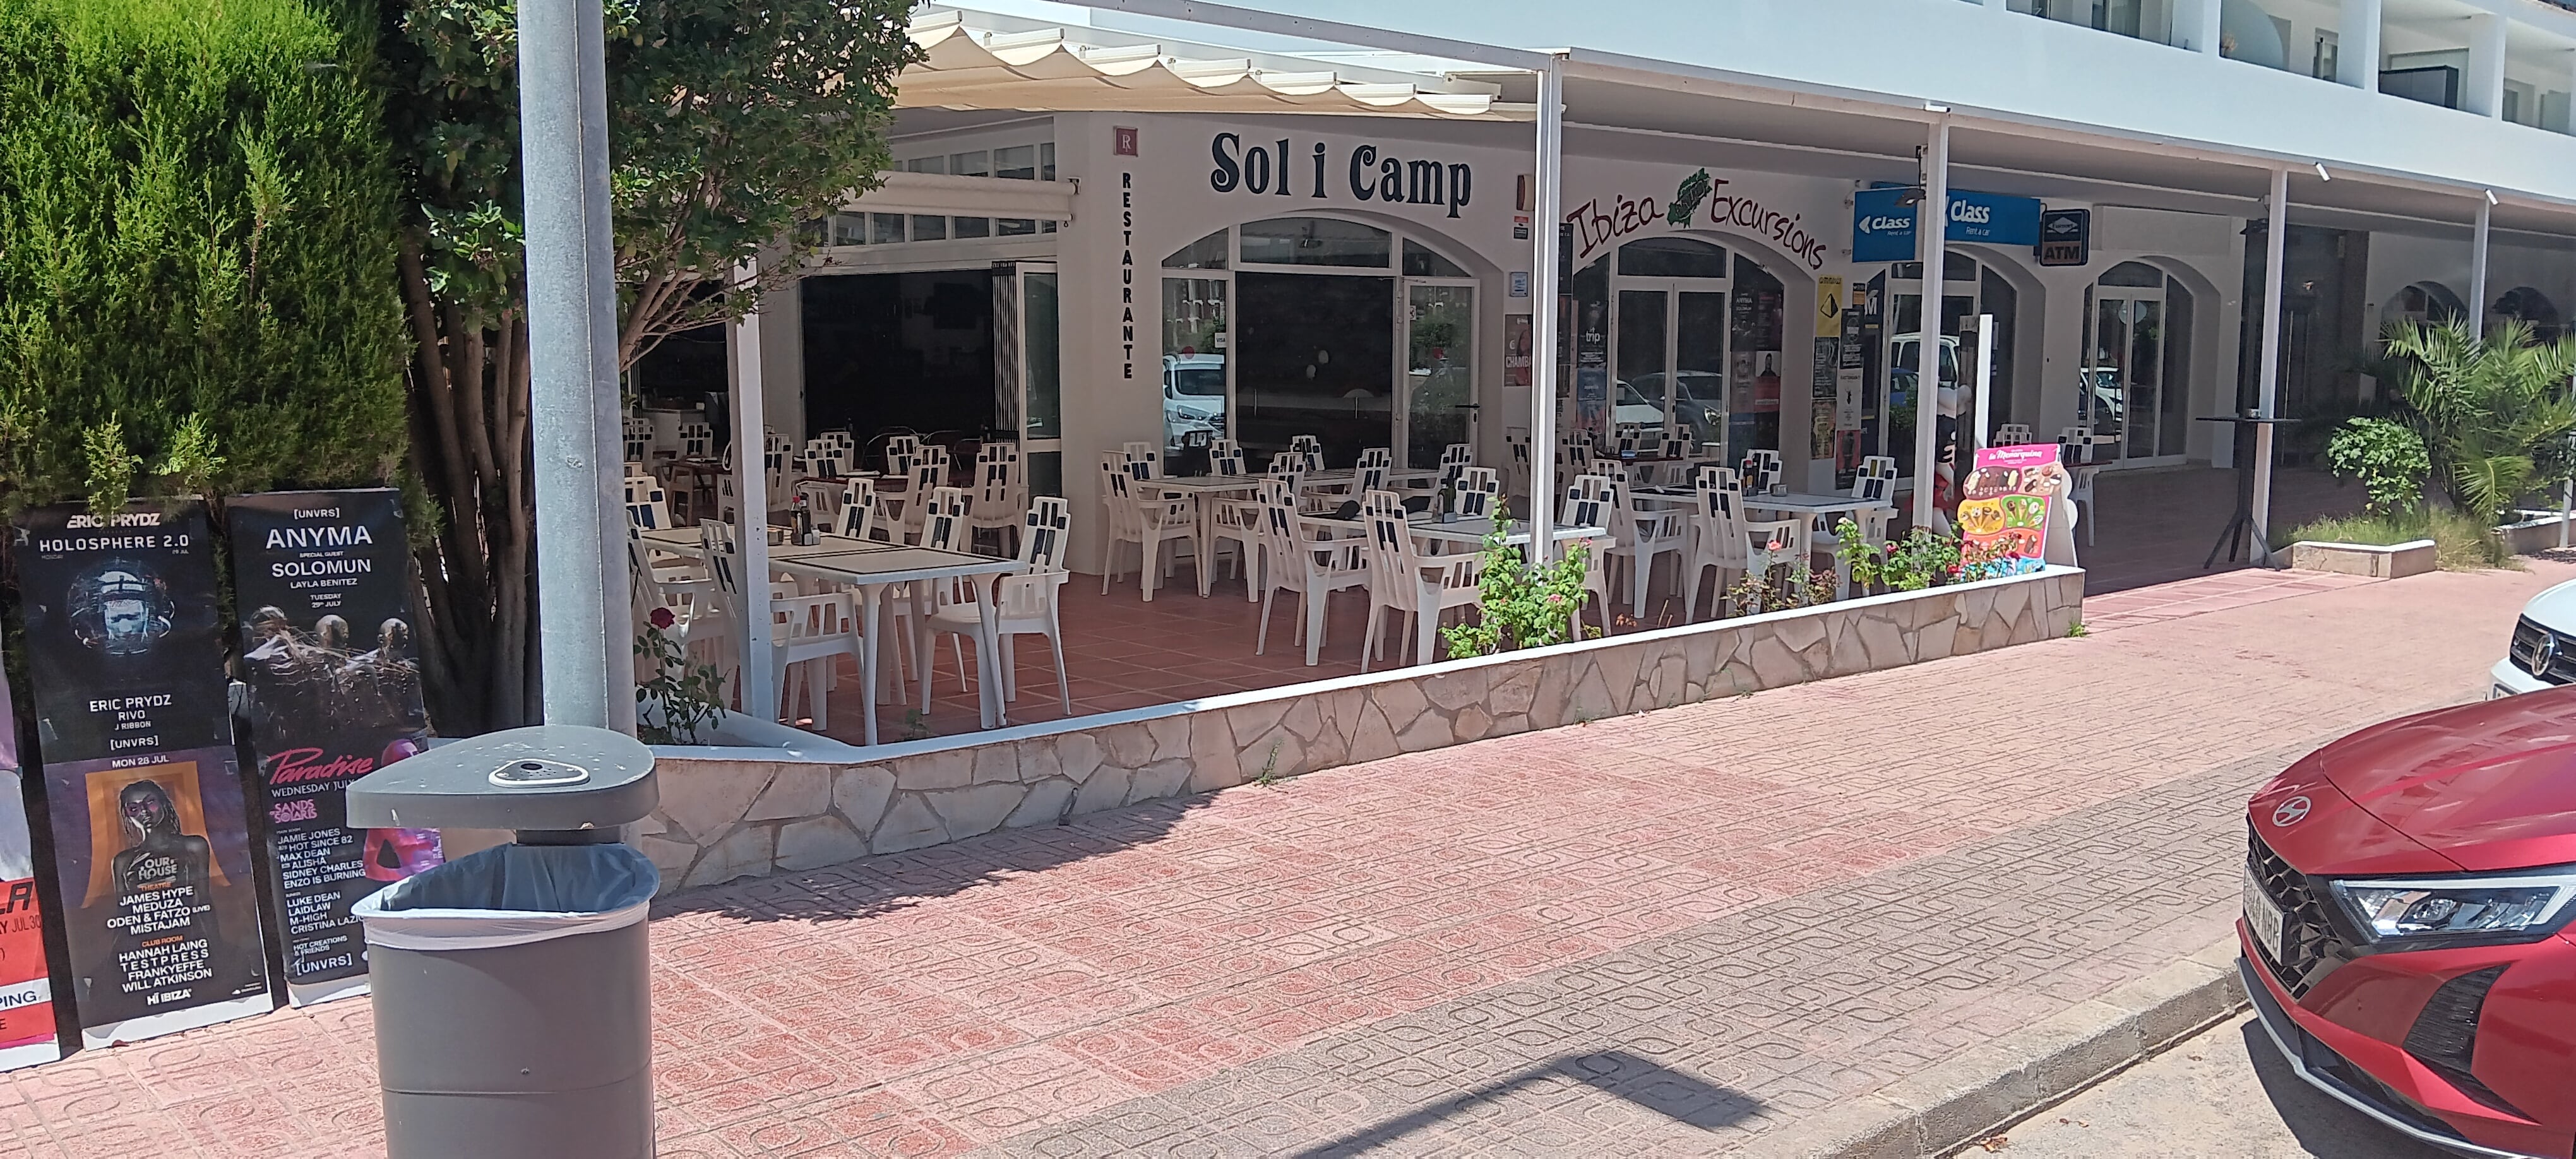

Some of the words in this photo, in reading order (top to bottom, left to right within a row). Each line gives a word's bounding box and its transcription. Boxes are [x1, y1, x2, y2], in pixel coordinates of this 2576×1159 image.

[1210, 133, 1291, 196] Sol
[1311, 142, 1327, 198] i
[1349, 145, 1471, 218] Camp
[1950, 199, 1991, 223] Class
[1566, 194, 1664, 259] Ibiza
[1710, 179, 1826, 270] Excursions
[1871, 216, 1911, 230] Class
[1966, 226, 1977, 235] Rent
[2044, 246, 2080, 259] ATM
[1122, 172, 1133, 379] RESTAURANTE
[67, 514, 105, 528] ERIC
[110, 513, 160, 526] PRYDZ
[294, 508, 340, 520] [UNVRS]
[40, 536, 156, 552] HOLOSPHERE
[163, 535, 189, 547] 2.0
[266, 525, 373, 549] ANYMA
[271, 559, 371, 578] SOLOMUN
[290, 581, 319, 589] LAYLA
[320, 578, 357, 587] BENITEZ
[90, 699, 122, 712] ERIC
[126, 694, 172, 708] PRYDZ
[118, 710, 145, 721] RIVO
[121, 721, 151, 730] RIBBON
[110, 735, 158, 751] [UNVRS]
[112, 759, 136, 768] MON
[152, 755, 169, 764] JUL
[267, 747, 374, 785] Paradise
[271, 782, 330, 798] WEDNESDAY
[275, 799, 314, 813] SANDS
[274, 809, 318, 823] SOLARIS
[278, 833, 307, 844] JAMIE
[309, 828, 340, 840] JONES
[289, 842, 309, 852] HOT
[311, 837, 340, 848] SINCE
[341, 835, 353, 843] 82
[145, 857, 170, 868] OUR
[280, 853, 302, 862] MAX
[304, 848, 331, 859] DEAN
[292, 857, 327, 869] ALISHA
[138, 864, 177, 880] HOUSE
[283, 867, 318, 880] SIDNEY
[320, 860, 363, 874] CHARLES
[284, 877, 311, 889] ENZO
[313, 876, 322, 884] IS
[323, 869, 366, 883] BURNING
[120, 891, 160, 906] JAMES
[162, 886, 193, 898] HYPE
[287, 896, 313, 908] LUKE
[314, 891, 341, 903] DEAN
[132, 898, 183, 914] MEDUZA
[288, 902, 331, 917] LAIDLAW
[11, 916, 28, 932] JUL
[107, 916, 141, 928] ODEN
[144, 913, 152, 922] &
[154, 907, 190, 920] FATZO
[290, 912, 328, 925] M-HIGH
[130, 917, 190, 935] MISTAJAM
[291, 920, 336, 934] CRISTINA
[119, 946, 170, 963] HANNAH
[172, 939, 208, 953] LAING
[293, 942, 308, 951] HOT
[309, 935, 347, 947] CREATIONS
[301, 945, 330, 954] FRIENDS
[128, 960, 205, 981] FRANKYEFFE
[295, 953, 353, 976] [UNVRS]
[122, 981, 152, 993] WILL
[153, 968, 213, 987] ATKINSON
[160, 989, 191, 1002] IBIZA
